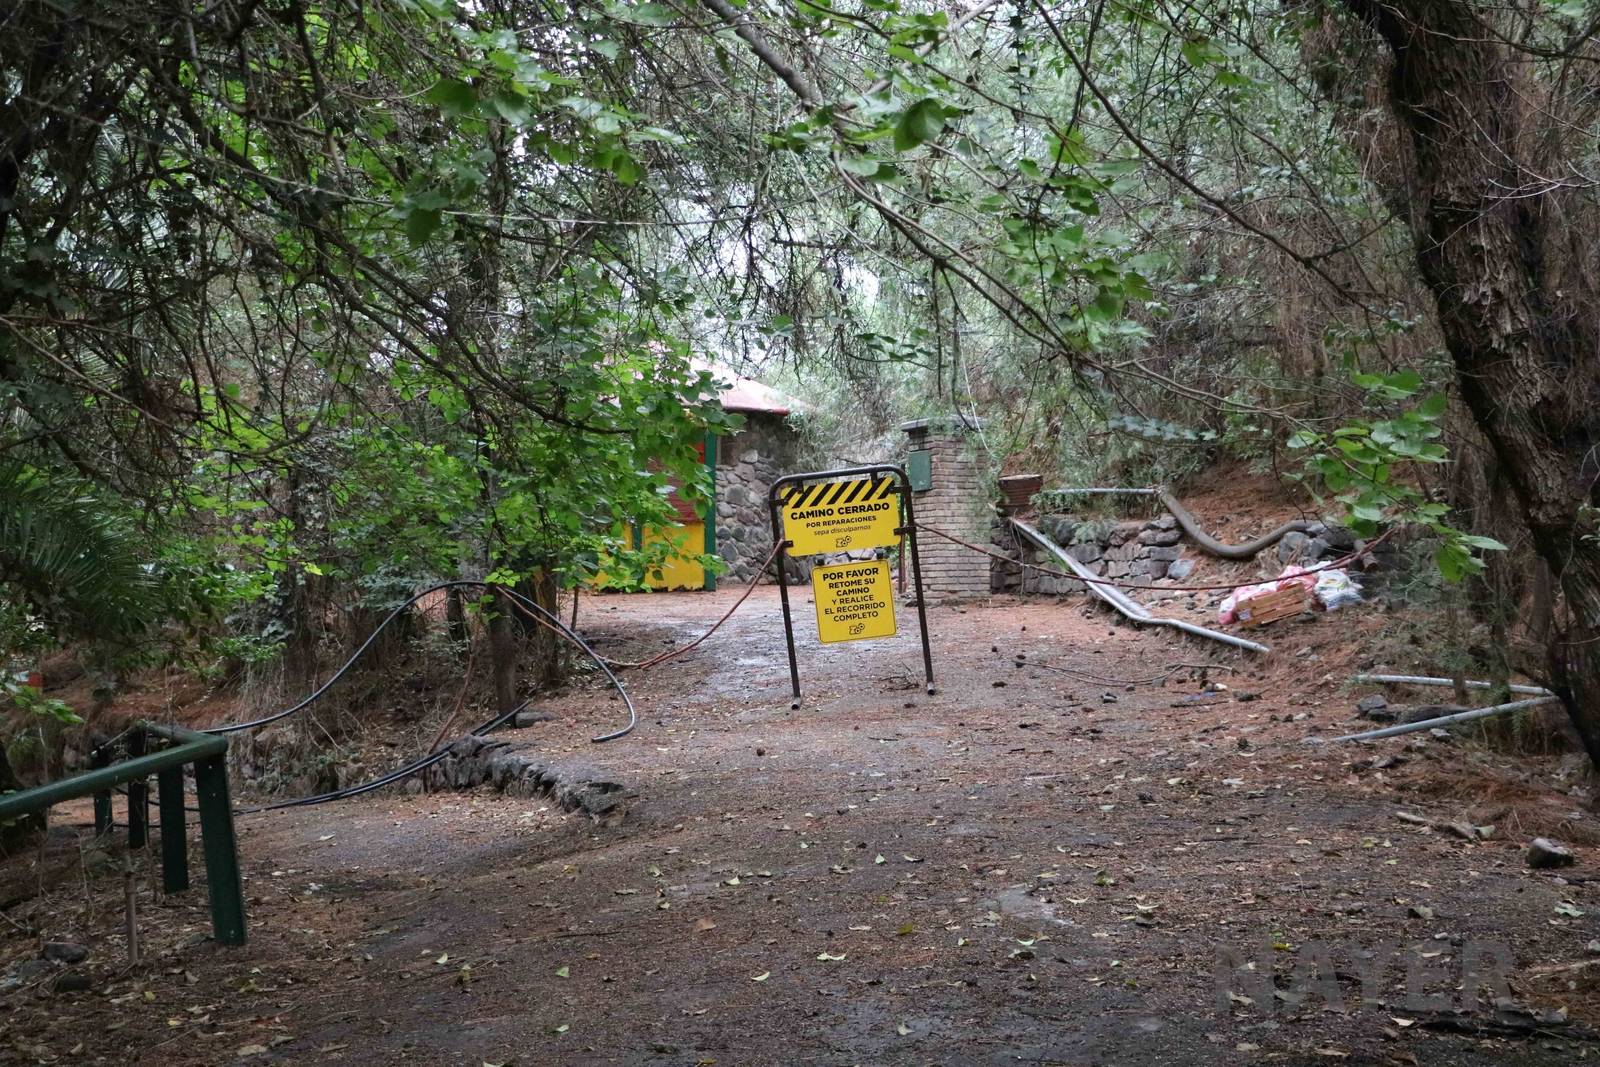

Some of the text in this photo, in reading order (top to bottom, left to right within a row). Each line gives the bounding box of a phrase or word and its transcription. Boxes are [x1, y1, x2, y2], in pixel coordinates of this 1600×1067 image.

[791, 502, 890, 520] CAMINO CERRADO
[806, 515, 877, 529] POR REPARACIONES
[814, 524, 871, 537] sepa disculparnos
[823, 567, 879, 581] POR FAVOR
[828, 577, 876, 589] RETOME SU
[836, 587, 870, 597] CAMINO
[840, 594, 874, 605] REALICE
[824, 601, 886, 615] EL RECORRIDO
[833, 610, 879, 622] COMPLETO
